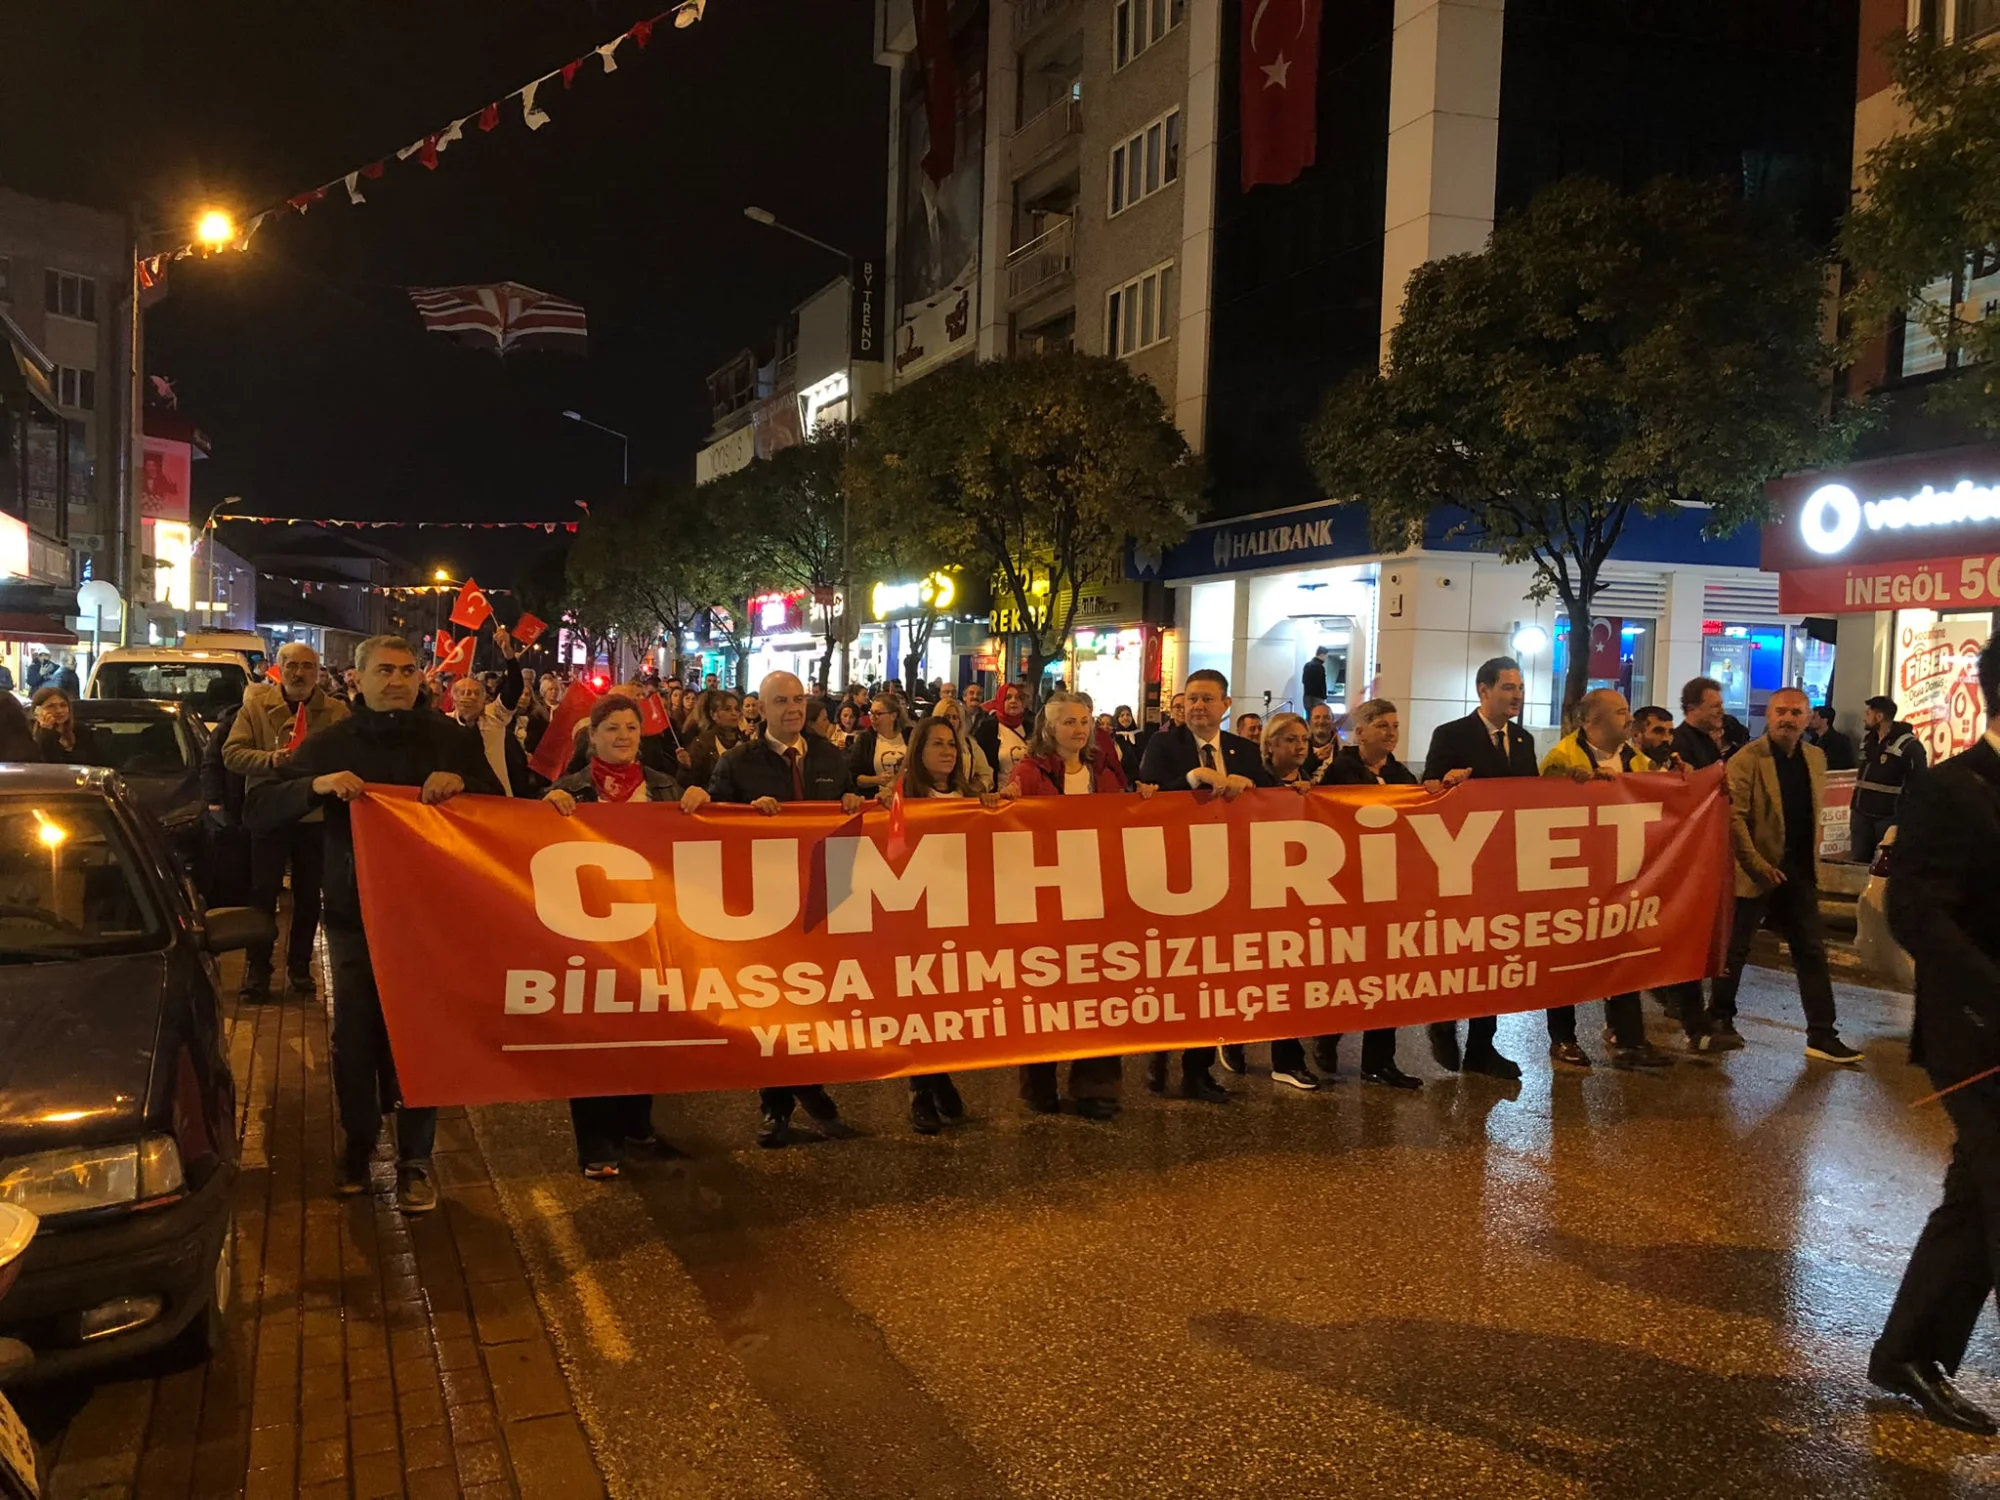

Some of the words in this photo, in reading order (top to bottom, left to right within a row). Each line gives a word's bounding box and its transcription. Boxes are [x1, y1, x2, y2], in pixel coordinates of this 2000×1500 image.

[864, 262, 873, 287] BY
[861, 290, 873, 351] TREND
[1233, 518, 1335, 560] HALKBANK
[990, 568, 1031, 596] FOO
[1845, 565, 1951, 606] İNEGÖL
[1835, 808, 1849, 821] GB
[530, 801, 1663, 944] CUMHURİYET
[504, 955, 875, 1015] BİLHASSA
[895, 917, 1366, 998] KİMSESİZLERİN
[1386, 889, 1660, 959] KİMSESİDİR
[750, 998, 1007, 1058] YENİPARTİ
[1023, 985, 1185, 1035] İNEGÖL
[1199, 981, 1290, 1023] İLÇE
[1304, 955, 1537, 1011] BAŞKANLIĞI
